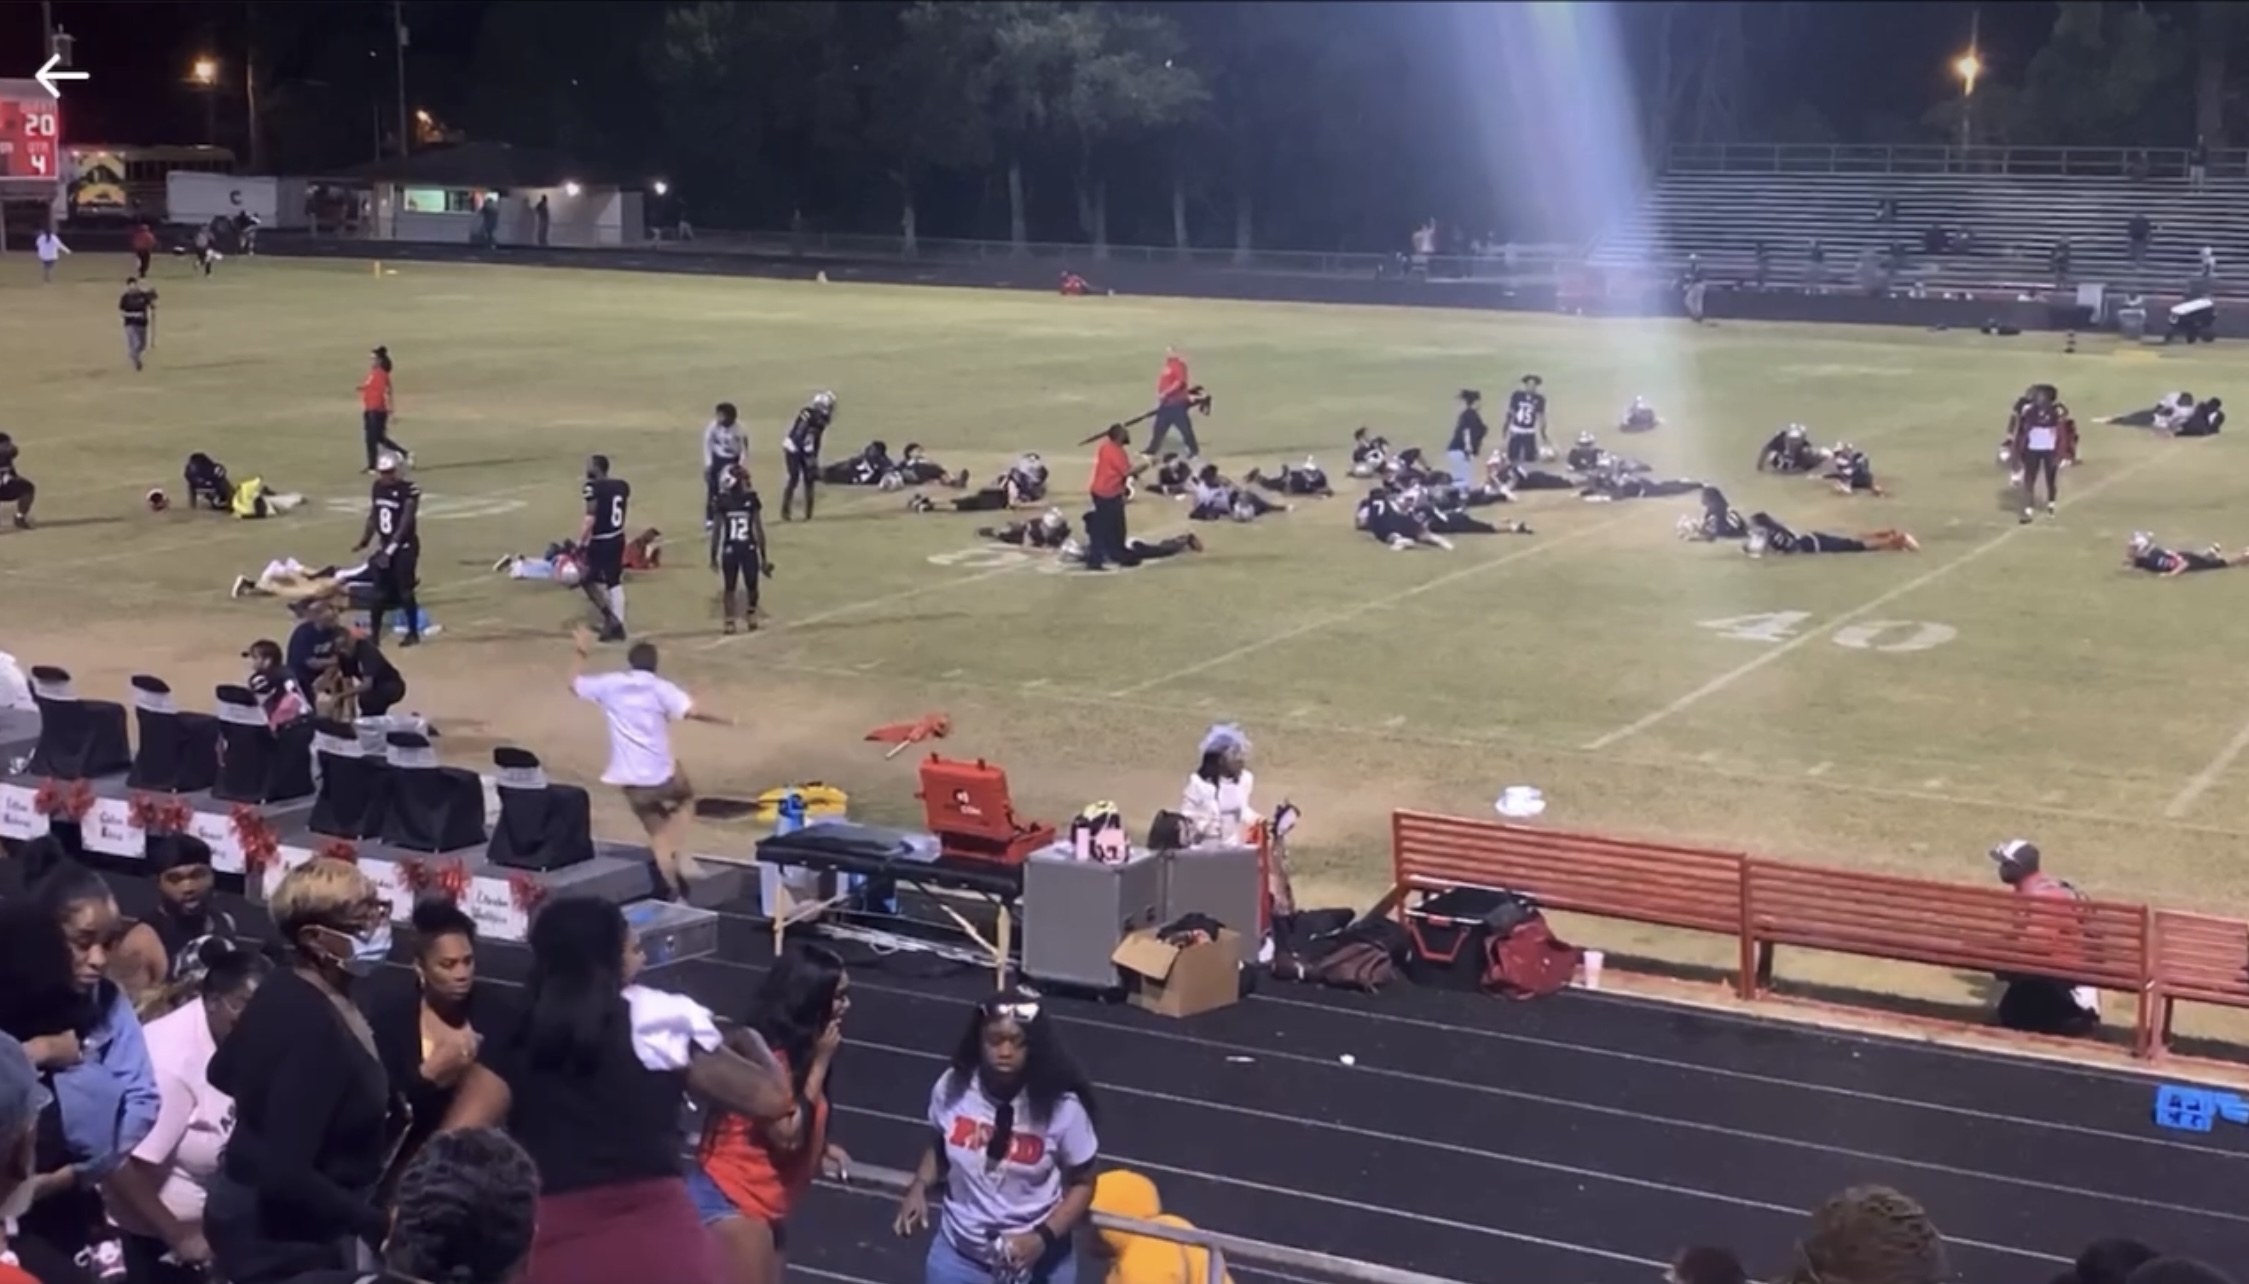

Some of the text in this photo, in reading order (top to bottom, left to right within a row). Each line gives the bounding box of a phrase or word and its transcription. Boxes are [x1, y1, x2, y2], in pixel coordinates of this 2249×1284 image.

[24, 112, 56, 136] 20
[30, 154, 46, 174] 4
[380, 507, 392, 534] 8
[611, 495, 623, 527] 6
[730, 518, 749, 541] 12
[1694, 609, 1957, 652] 40
